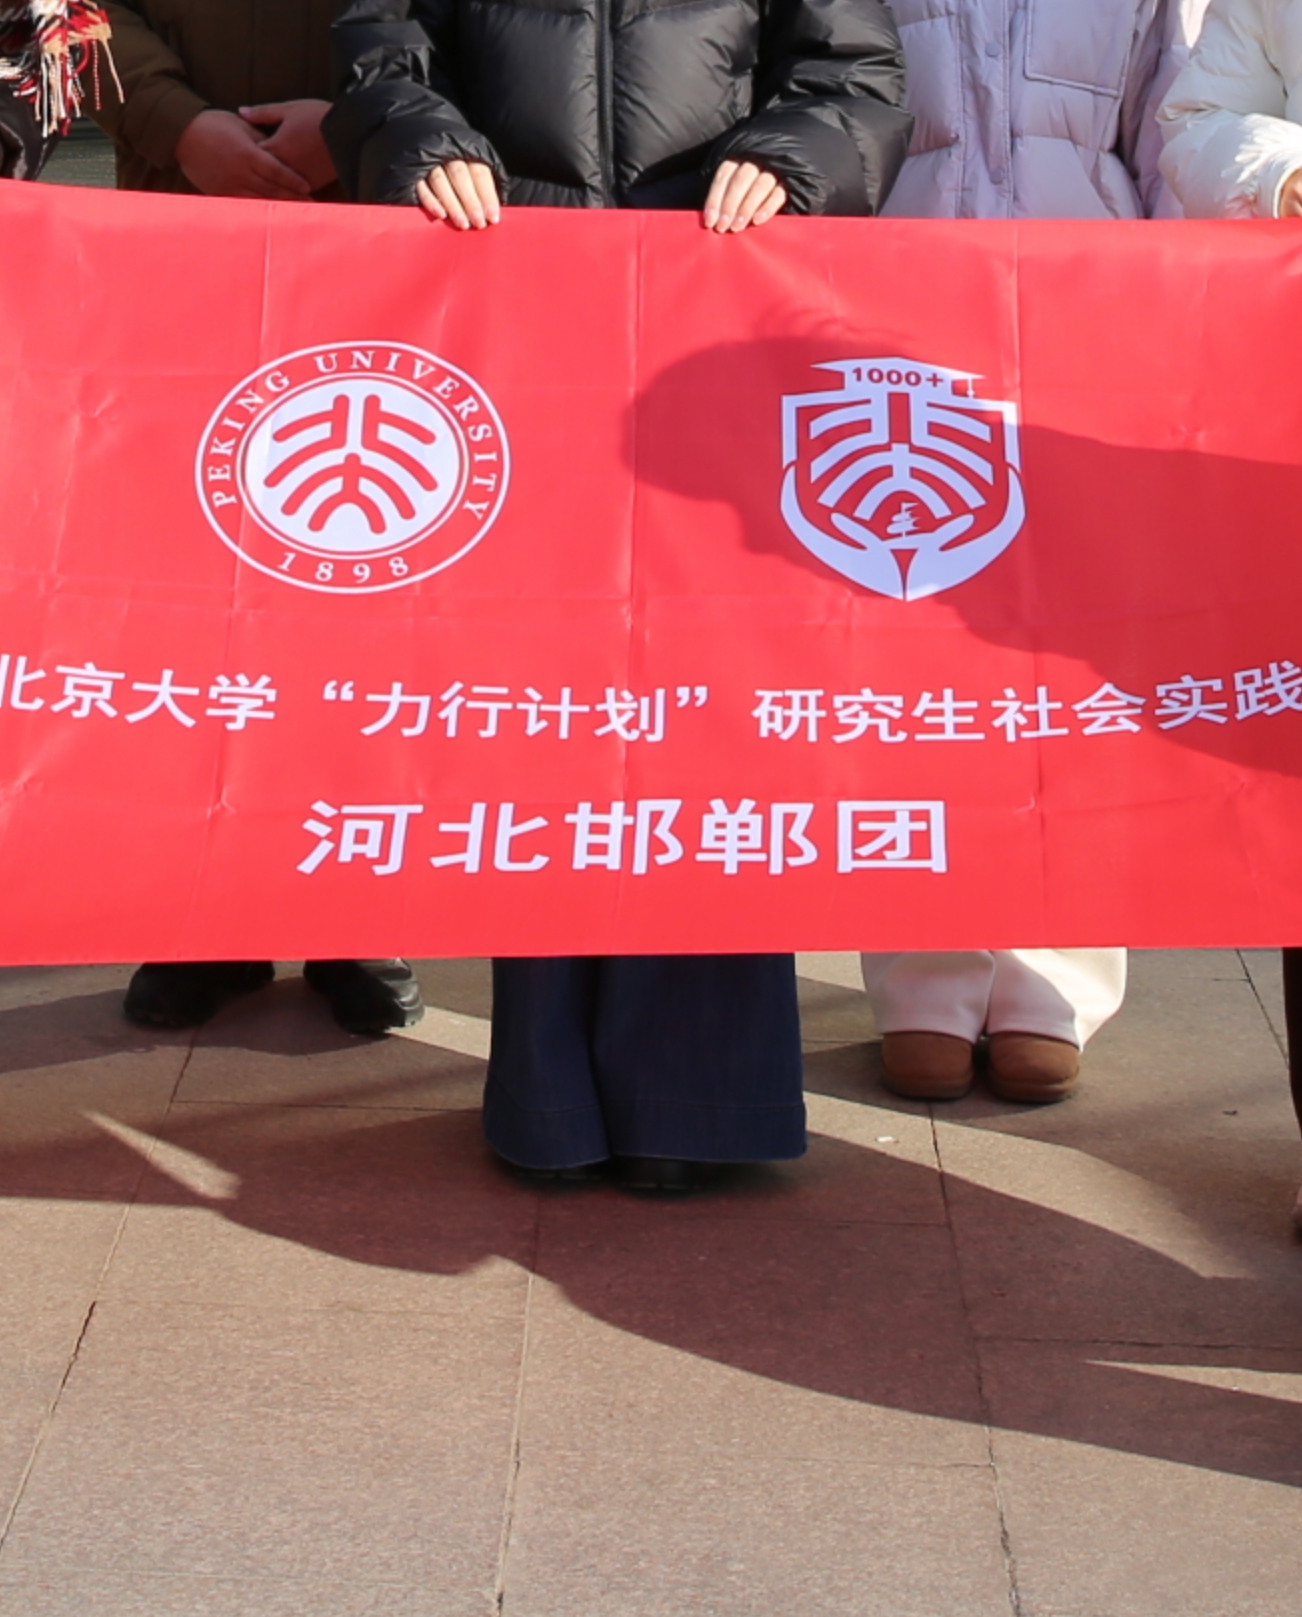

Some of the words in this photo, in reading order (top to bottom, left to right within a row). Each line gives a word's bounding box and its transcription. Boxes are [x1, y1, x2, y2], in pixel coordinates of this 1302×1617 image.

[208, 370, 290, 508] PEKING
[314, 350, 498, 521] UNIVERSITY
[277, 551, 410, 583] 1898
[296, 798, 948, 877] 河北邯郸团
